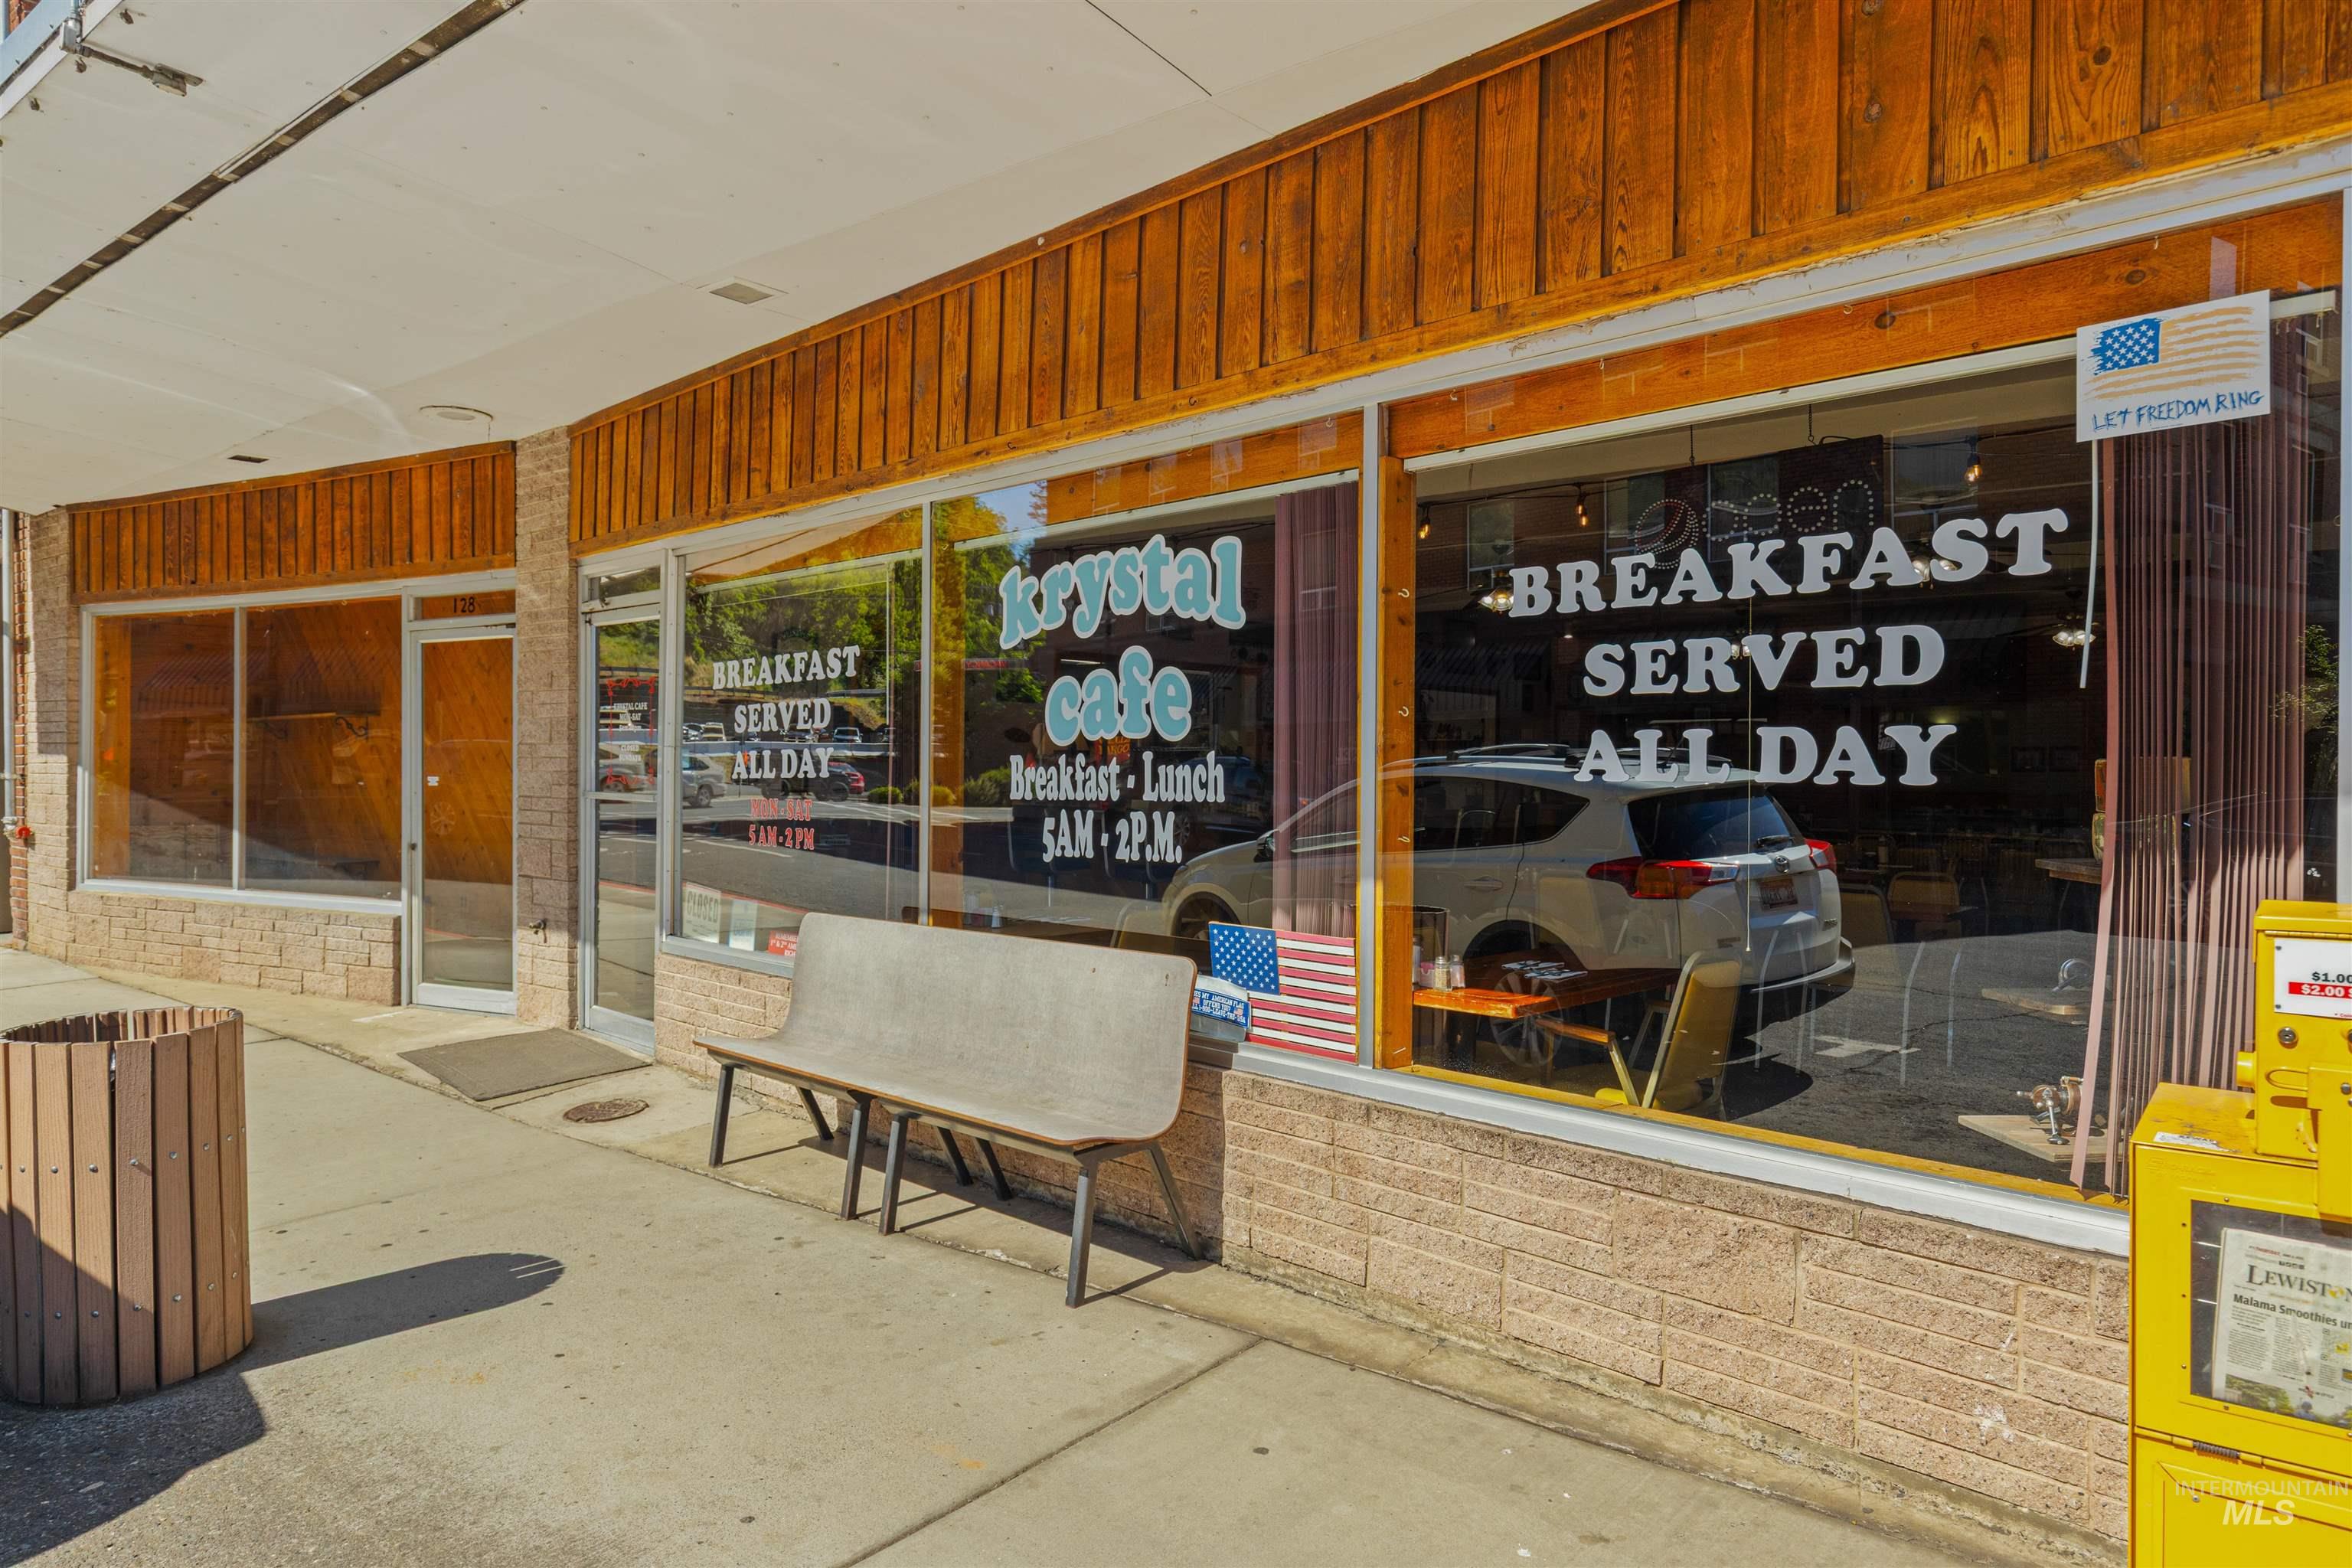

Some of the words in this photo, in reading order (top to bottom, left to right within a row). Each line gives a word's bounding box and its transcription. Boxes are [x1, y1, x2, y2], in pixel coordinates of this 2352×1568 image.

[2092, 406, 2132, 433] LET
[2135, 397, 2211, 426] FREEDOM
[2215, 390, 2265, 414] RING
[1508, 508, 2069, 617] BREAKFAST
[453, 596, 475, 612] 128
[999, 534, 1246, 650] krystal
[713, 645, 861, 689] BREAKFAST
[1583, 625, 1945, 697] SERVED
[734, 697, 831, 733] SERVED
[1045, 645, 1193, 746] cafe
[732, 750, 776, 779] ALL
[780, 747, 834, 779] DAY
[1573, 728, 1732, 784] ALL
[1753, 724, 1958, 786] DAY
[1010, 752, 1120, 802] Breakfast
[1142, 750, 1226, 803] Lunch
[750, 798, 779, 818] MON
[786, 799, 813, 822] SAT
[1042, 809, 1094, 864] 5AM
[687, 890, 719, 923] CLOSED
[2301, 984, 2345, 998] $2.00
[2311, 971, 2352, 984] $1.00
[1212, 995, 1233, 1006] AMERICAN
[1233, 1001, 1243, 1009] FLAG
[2233, 1293, 2276, 1312] Malama
[2278, 1305, 2337, 1327] Smoothies
